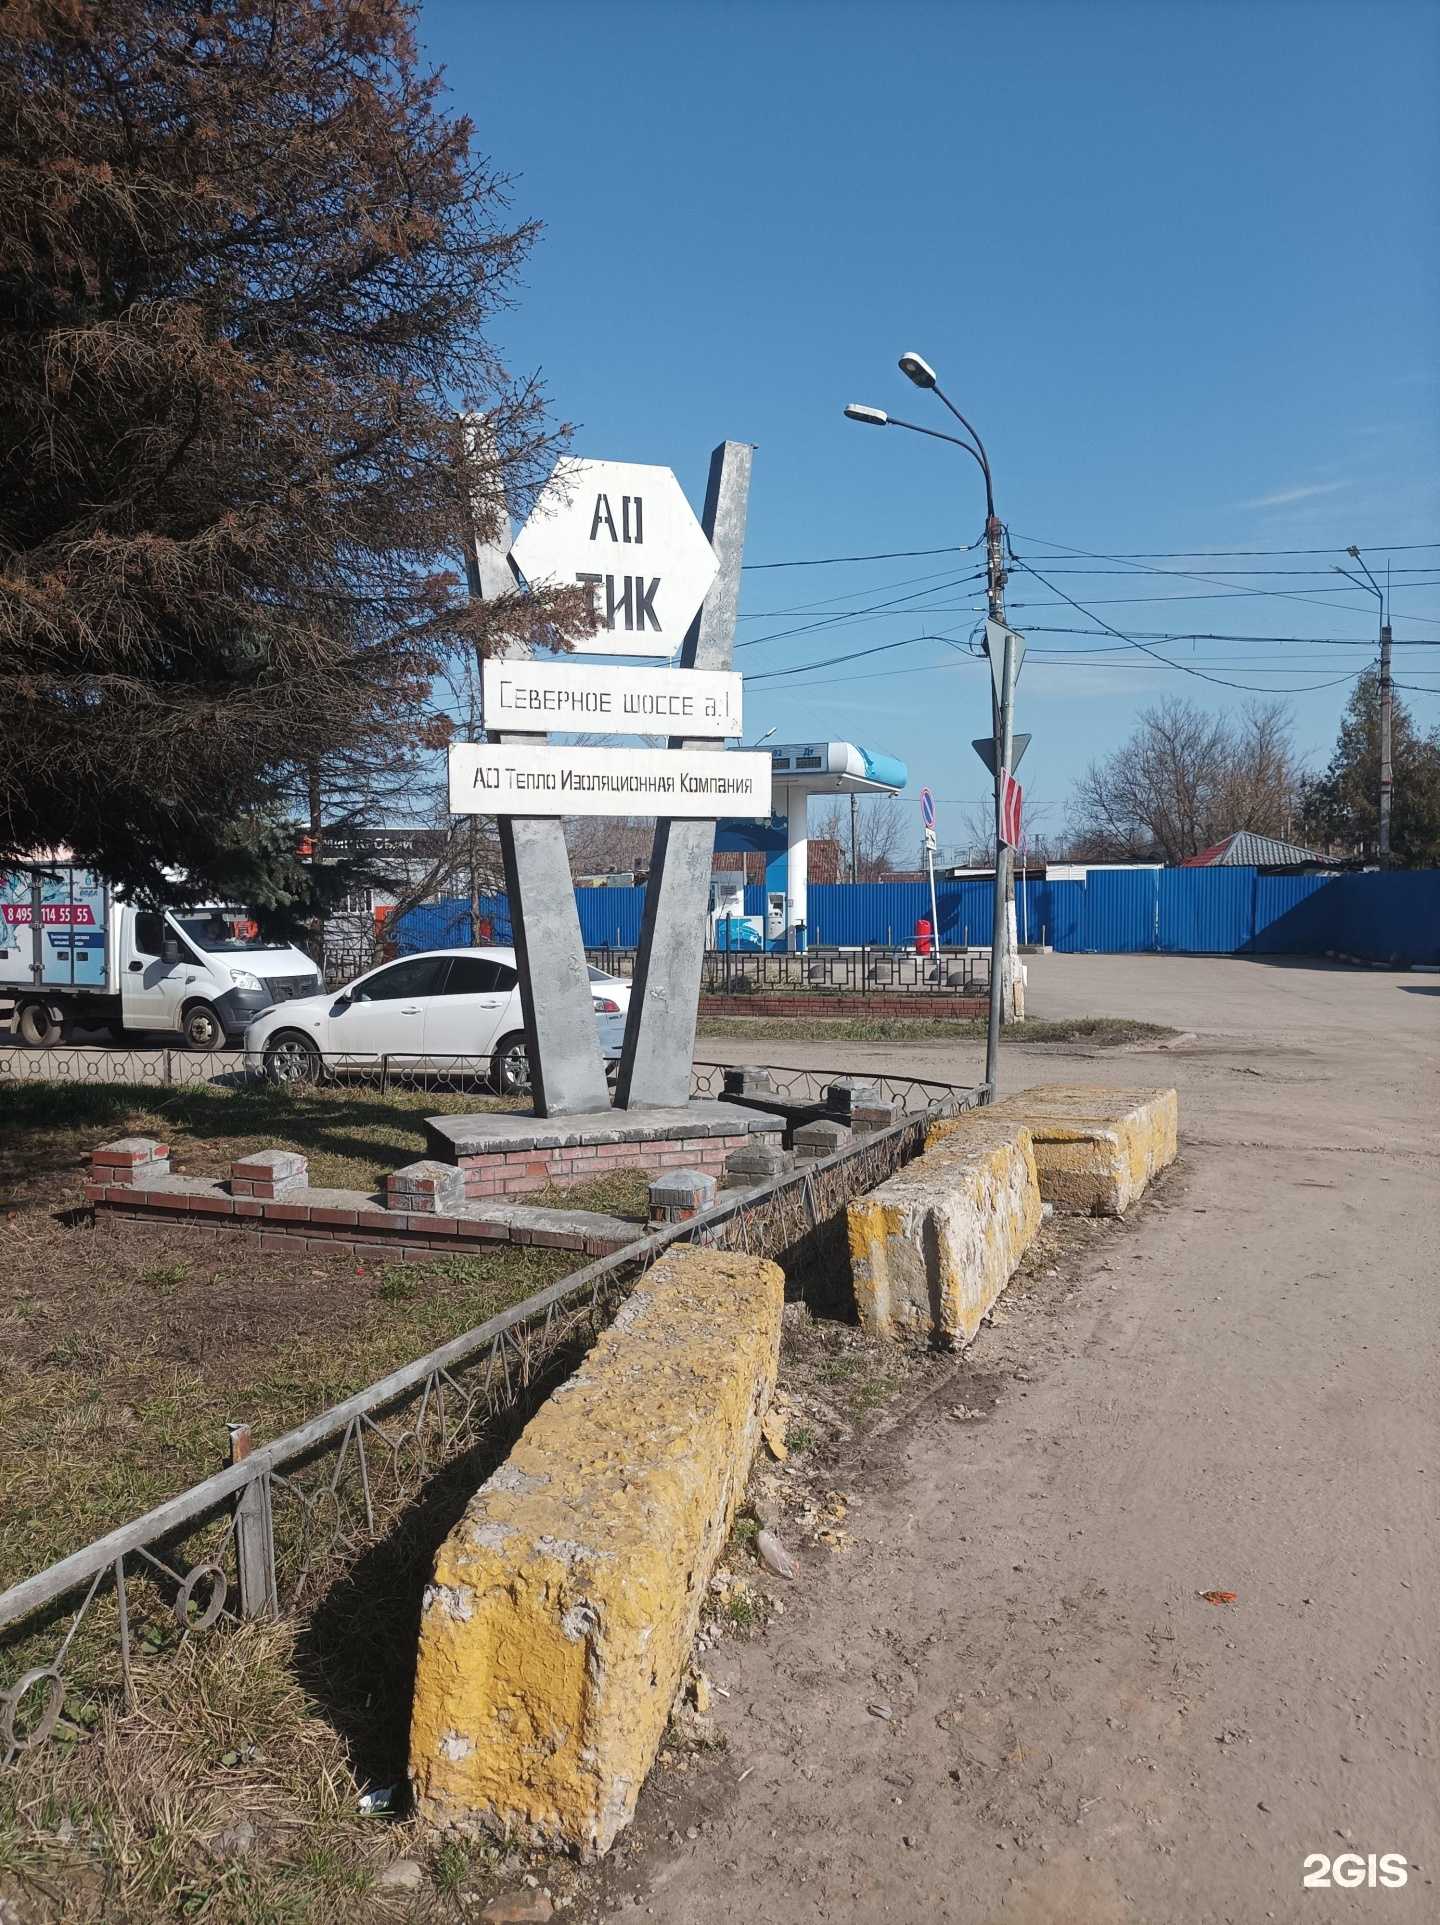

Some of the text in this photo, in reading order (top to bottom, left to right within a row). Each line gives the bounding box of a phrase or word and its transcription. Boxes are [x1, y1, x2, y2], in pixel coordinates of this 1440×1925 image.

[590, 493, 643, 544] АО
[575, 572, 663, 632] ТИК
[472, 767, 500, 789] АО
[561, 769, 675, 793] Изоляционная
[680, 772, 753, 794] Компания
[8, 907, 88, 922] 8 495 114 55 55
